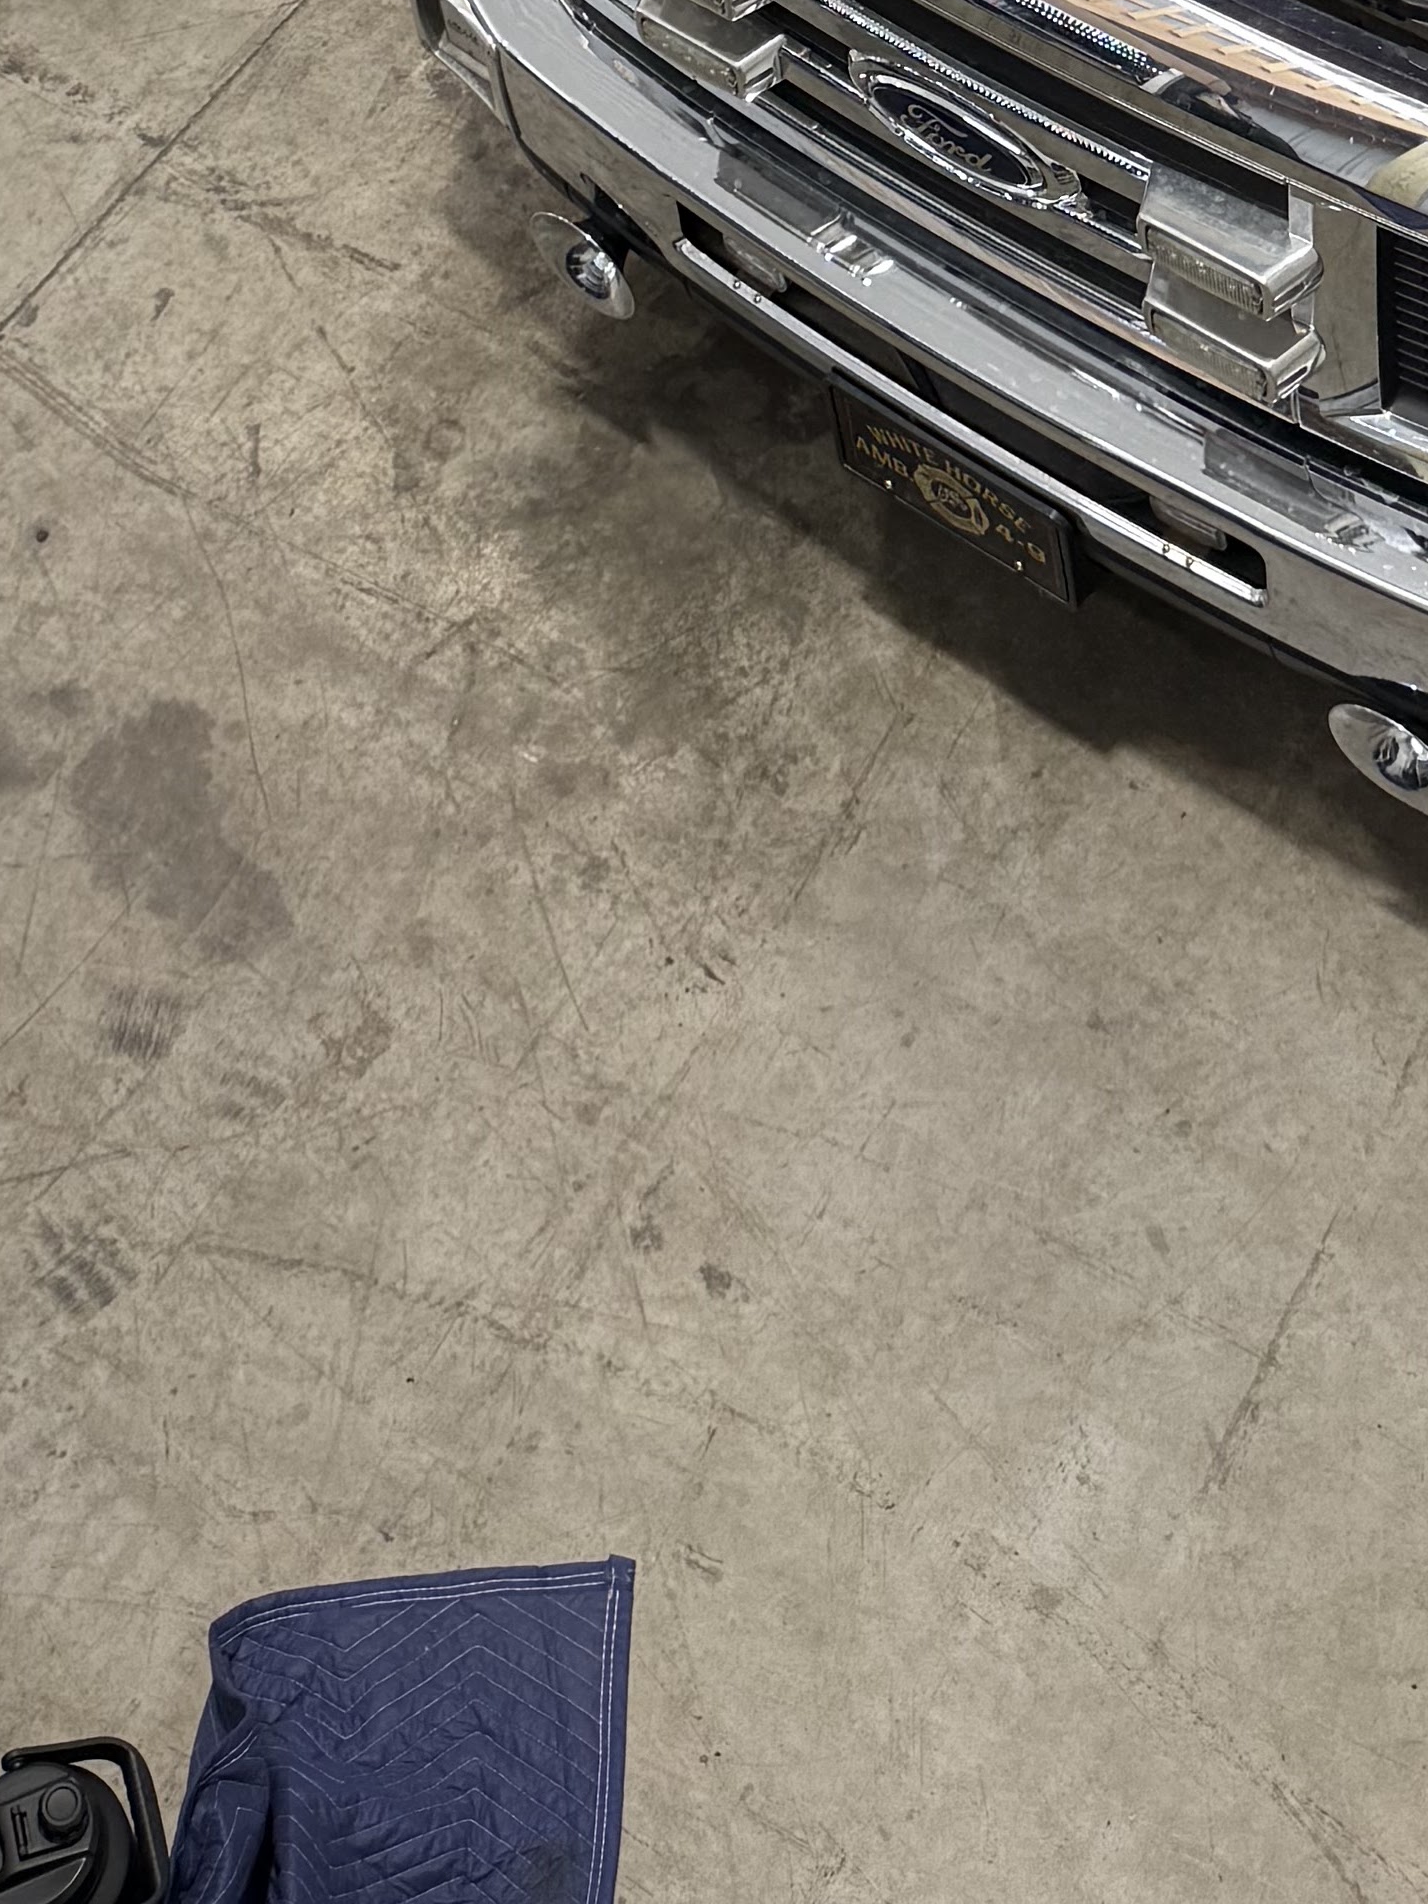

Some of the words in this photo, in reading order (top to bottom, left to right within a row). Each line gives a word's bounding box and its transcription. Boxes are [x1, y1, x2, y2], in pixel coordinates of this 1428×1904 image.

[899, 103, 993, 173] Ford
[866, 423, 941, 465] WHITE
[945, 459, 1032, 534] HORSE
